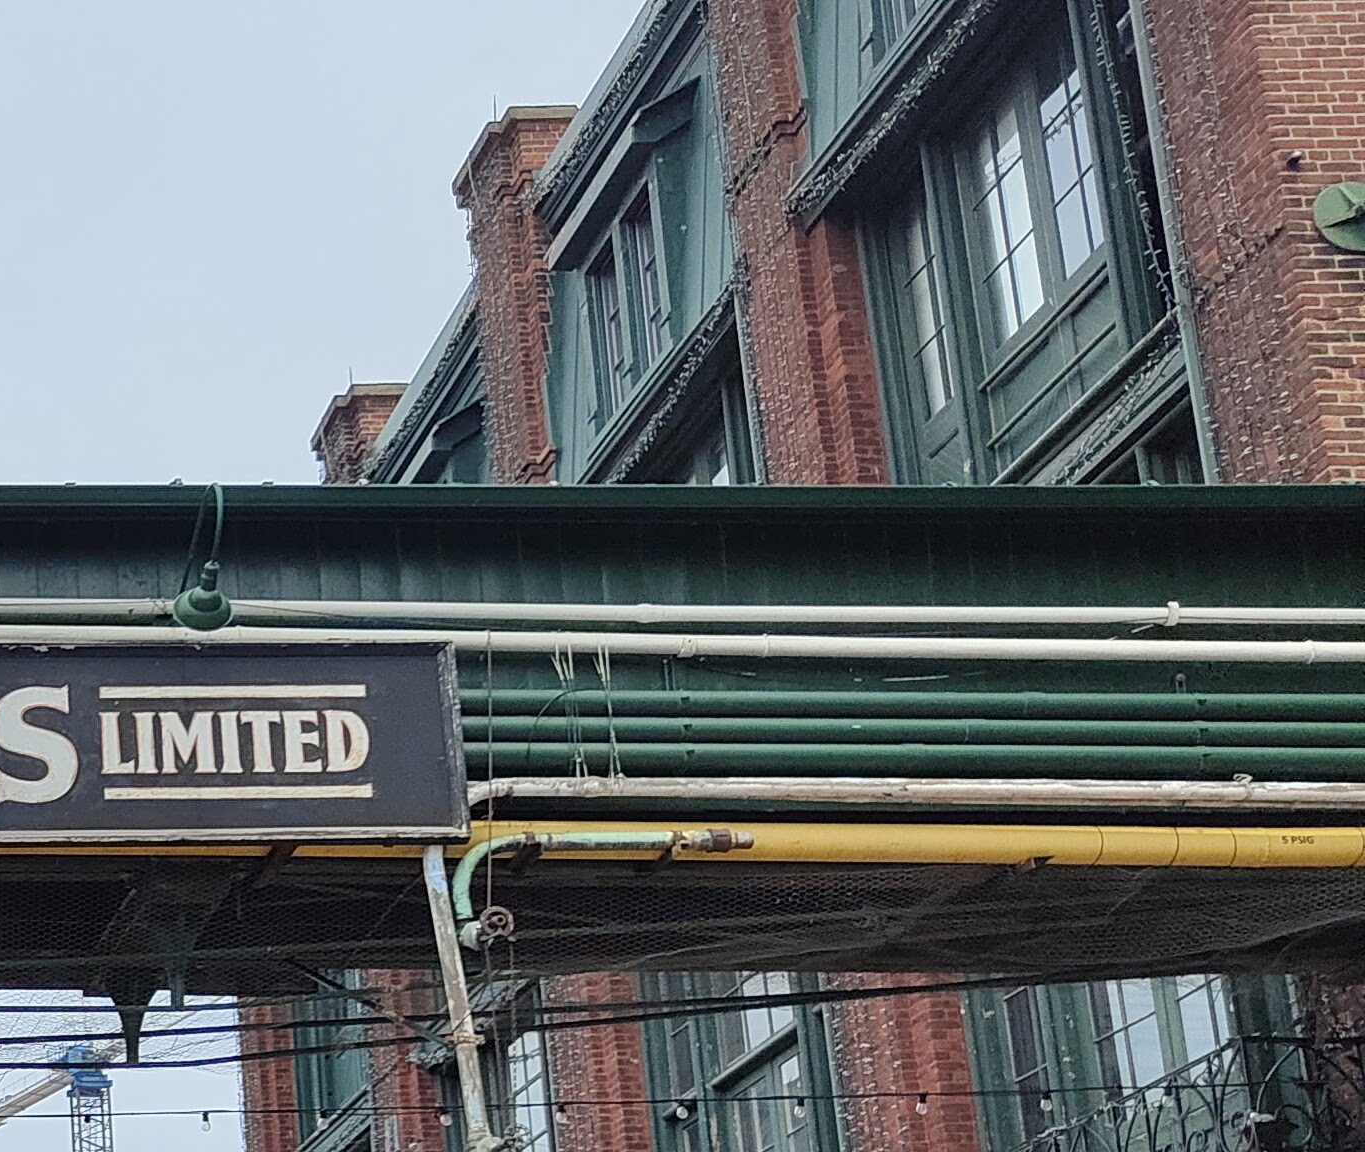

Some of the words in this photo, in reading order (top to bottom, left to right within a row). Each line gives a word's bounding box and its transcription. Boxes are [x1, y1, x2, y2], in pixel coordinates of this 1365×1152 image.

[98, 709, 370, 776] LIMITED
[1281, 835, 1289, 845] 5
[1290, 835, 1315, 845] PSIG
